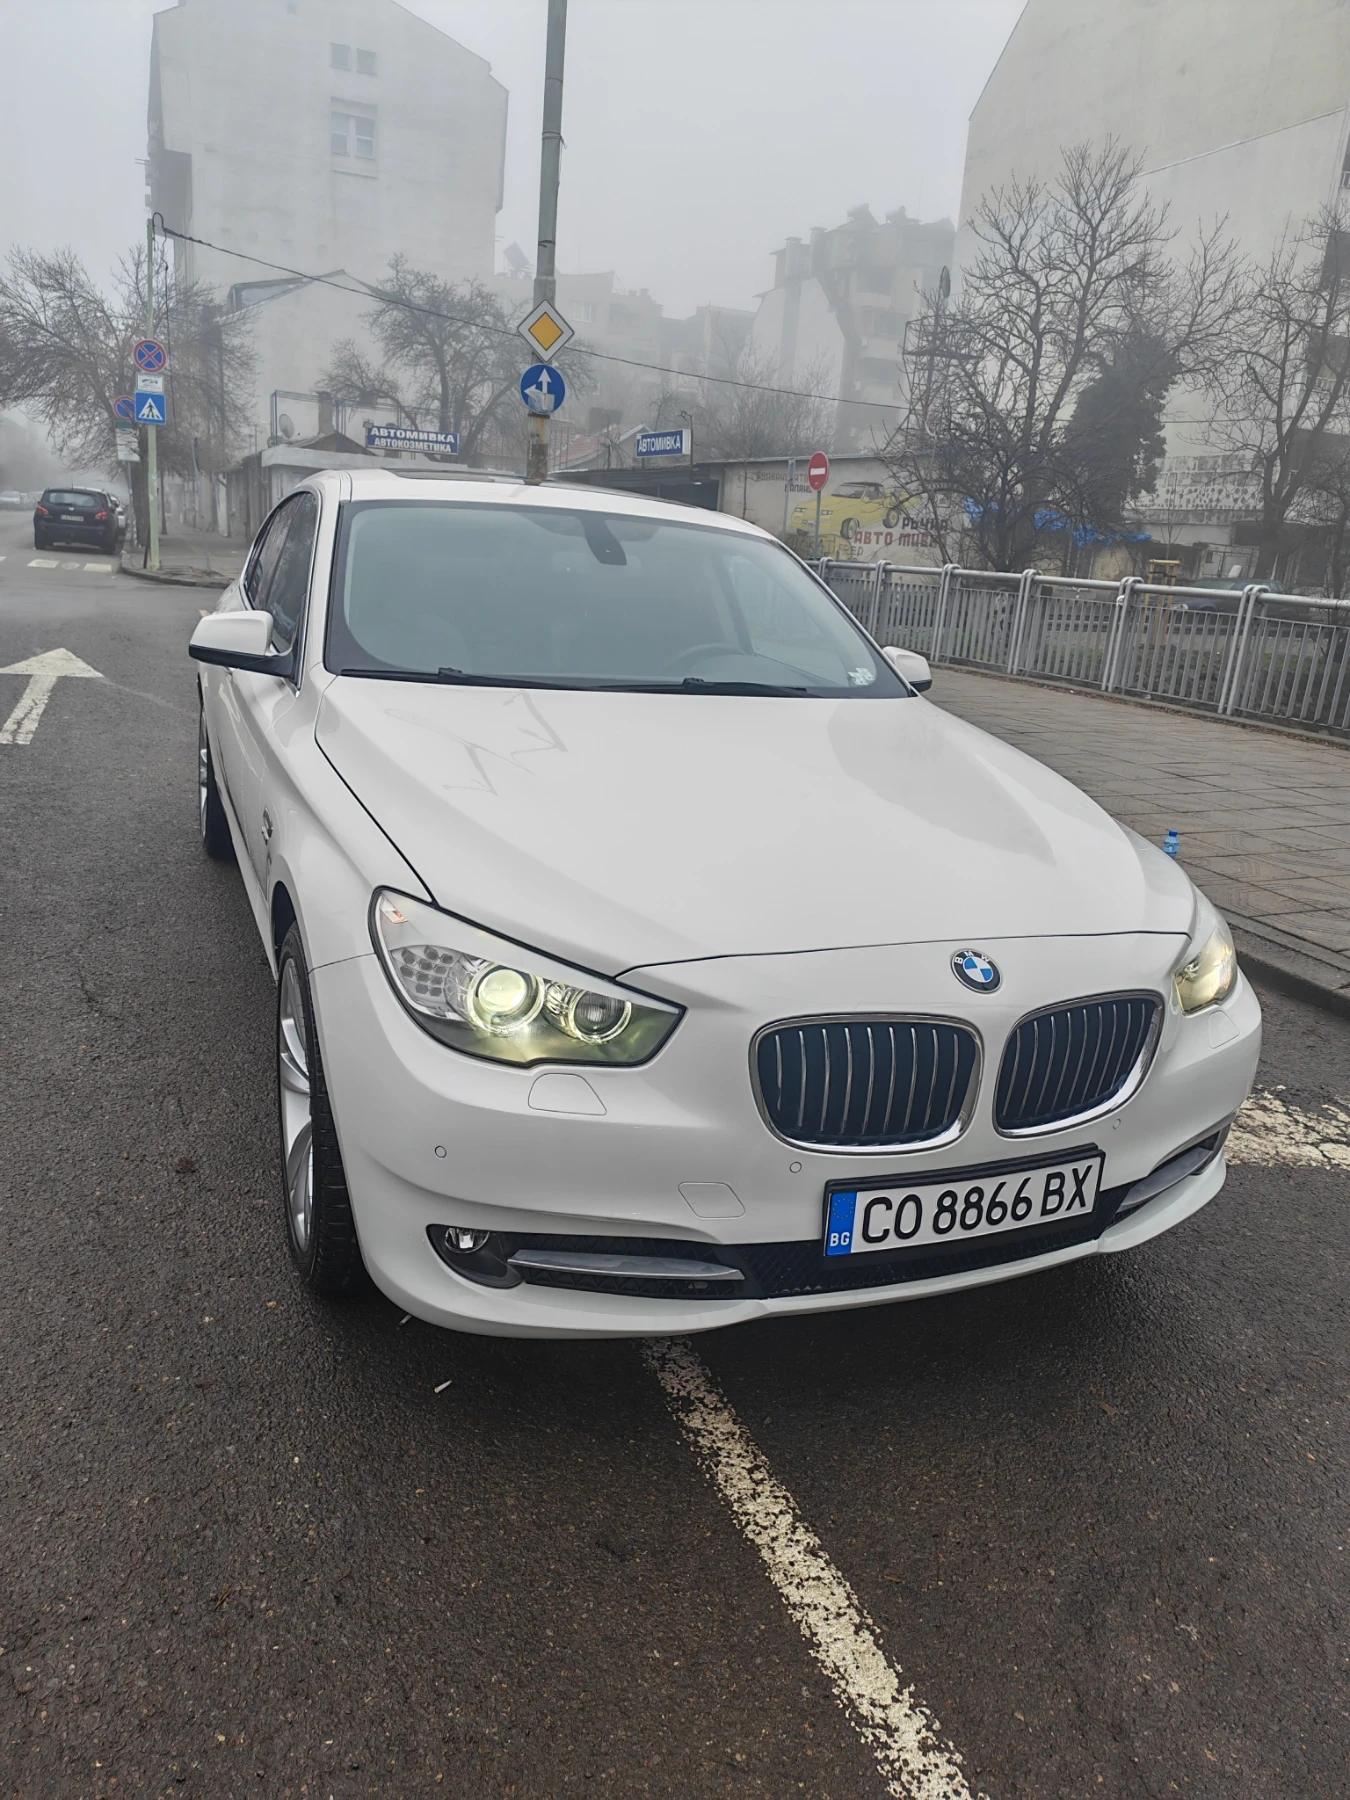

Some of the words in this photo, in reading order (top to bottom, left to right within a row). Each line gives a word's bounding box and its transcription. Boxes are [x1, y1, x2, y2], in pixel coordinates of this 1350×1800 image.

[370, 427, 455, 443] АВТОМИВКА
[374, 438, 452, 453] АВТОКОЗМЕТИКА
[638, 435, 681, 452] АВТОМИВКА
[854, 531, 893, 546] АВТО
[830, 1232, 850, 1247] BG
[862, 1194, 923, 1244] CO
[932, 1177, 1032, 1235] 8866
[1040, 1164, 1093, 1217] BX
